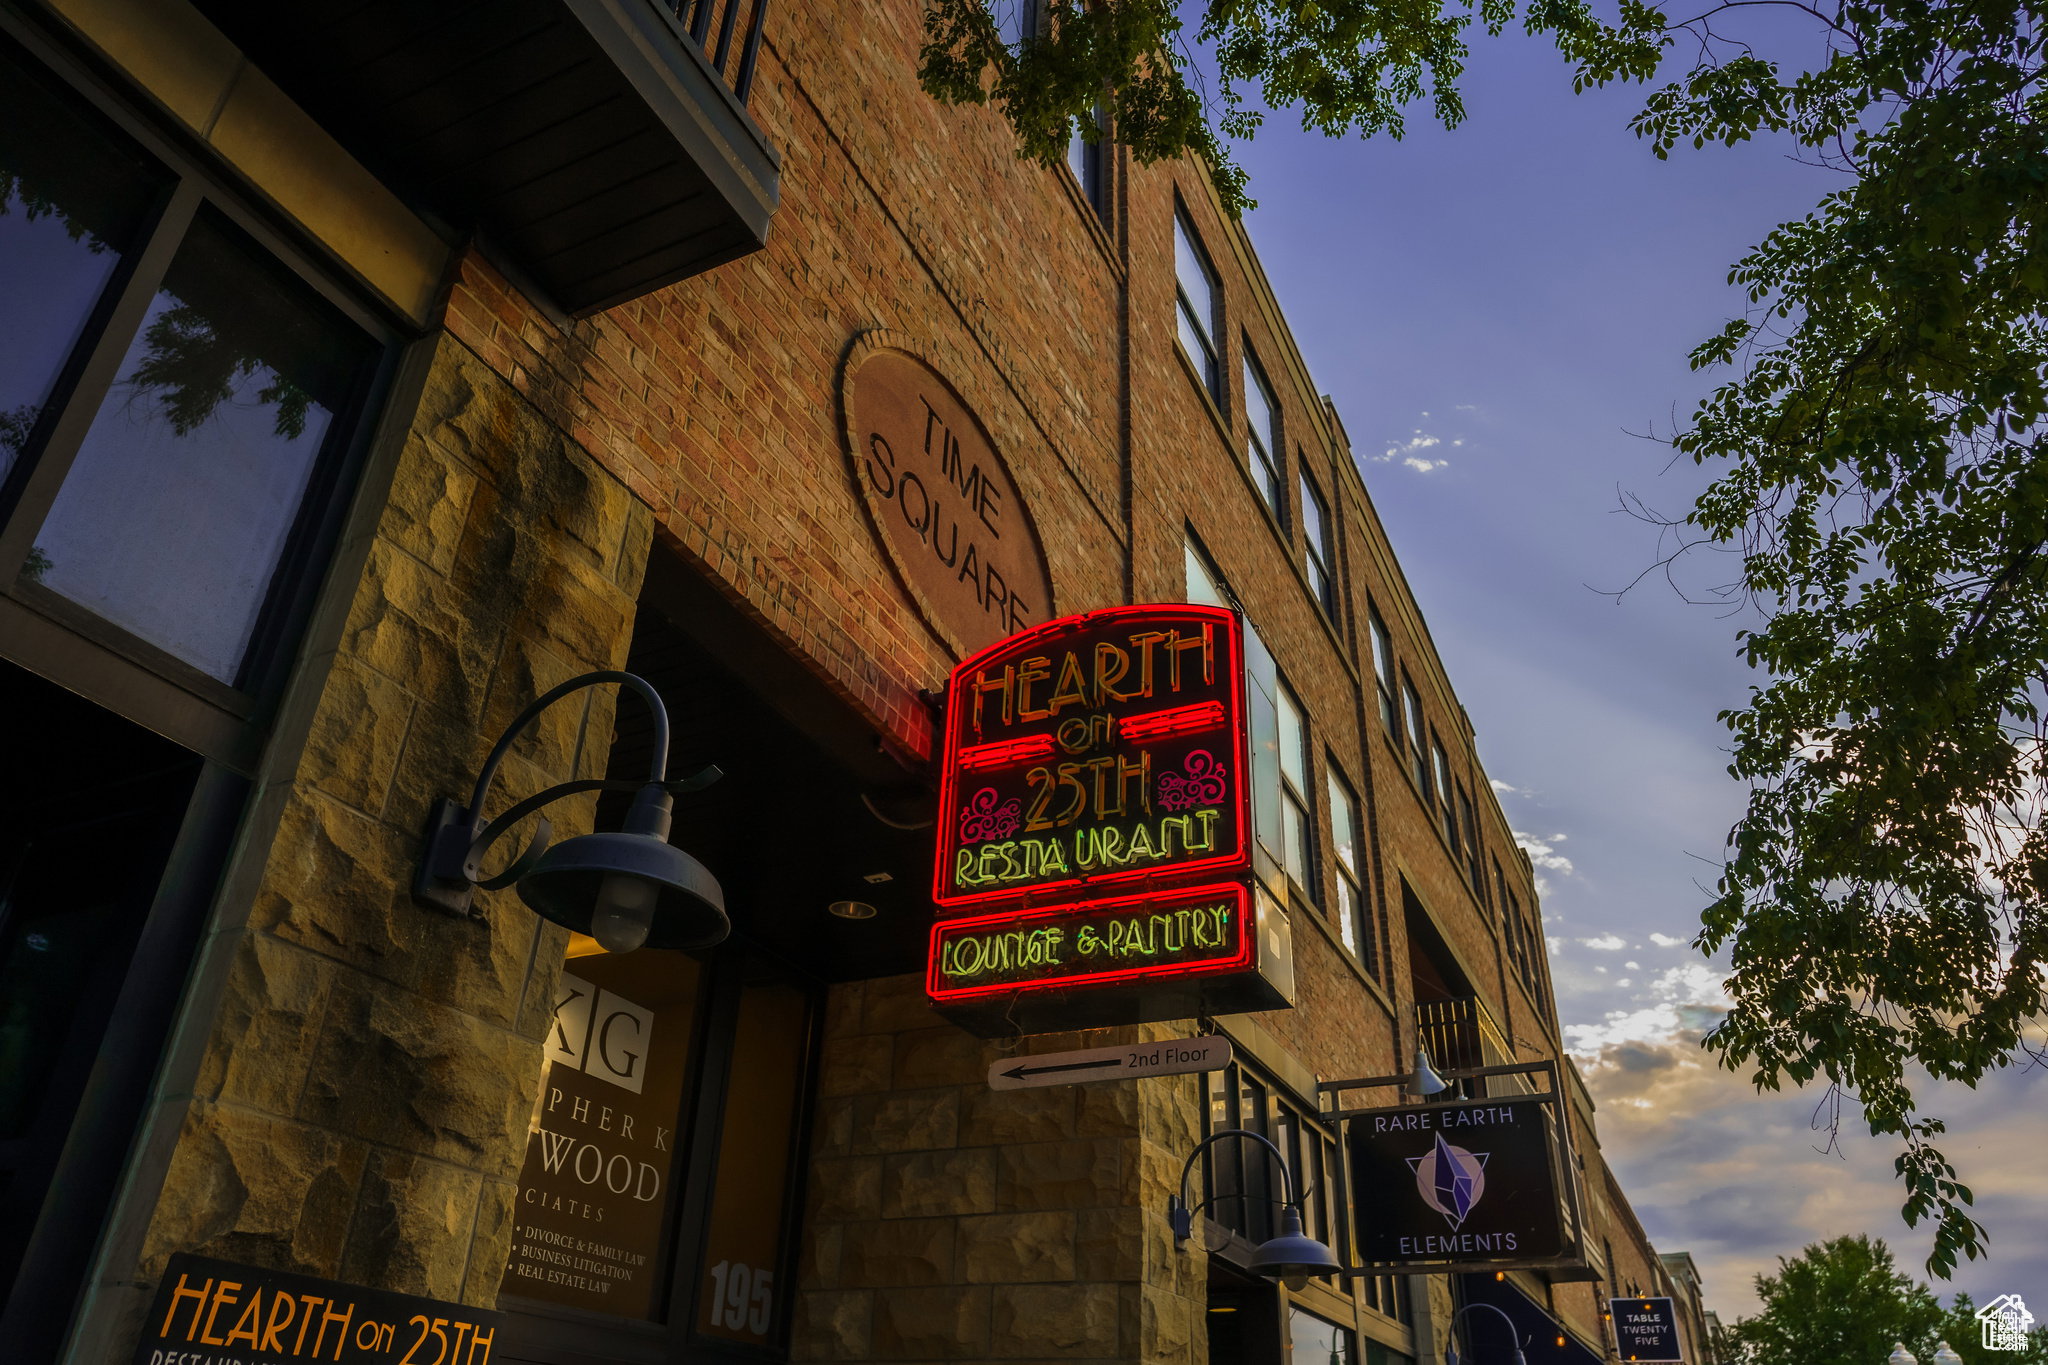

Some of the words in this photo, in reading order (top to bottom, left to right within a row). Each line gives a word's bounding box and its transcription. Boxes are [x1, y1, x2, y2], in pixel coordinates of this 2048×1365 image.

[919, 393, 1000, 540] TIME
[971, 621, 1215, 732] HEARTH
[1023, 750, 1152, 833] 25TH
[941, 927, 1064, 976] LOUNGE
[1128, 1049, 1160, 1069] 2nd
[1165, 1047, 1210, 1065] Floor
[1375, 1113, 1431, 1133] RARE
[1442, 1106, 1514, 1128] EARTH
[653, 1125, 671, 1152] K
[539, 1127, 660, 1202] WOOD
[525, 1225, 575, 1249] DIVORCE
[576, 1240, 586, 1252] &
[587, 1242, 624, 1261] FAMILY
[625, 1251, 646, 1267] LAW
[1400, 1232, 1518, 1255] ELEMENTS
[517, 1263, 545, 1281] REAL
[548, 1269, 586, 1290] ESTATE
[588, 1280, 611, 1294] LAW
[521, 1244, 572, 1268] BUSINESS
[574, 1257, 633, 1281] LITIGATION
[711, 1260, 774, 1336] 195
[160, 1273, 355, 1361] HEARTH
[398, 1314, 495, 1365] 25TH
[1622, 1324, 1668, 1334] TWENTY
[1626, 1313, 1661, 1323] TABLE
[1634, 1336, 1660, 1345] FIVE
